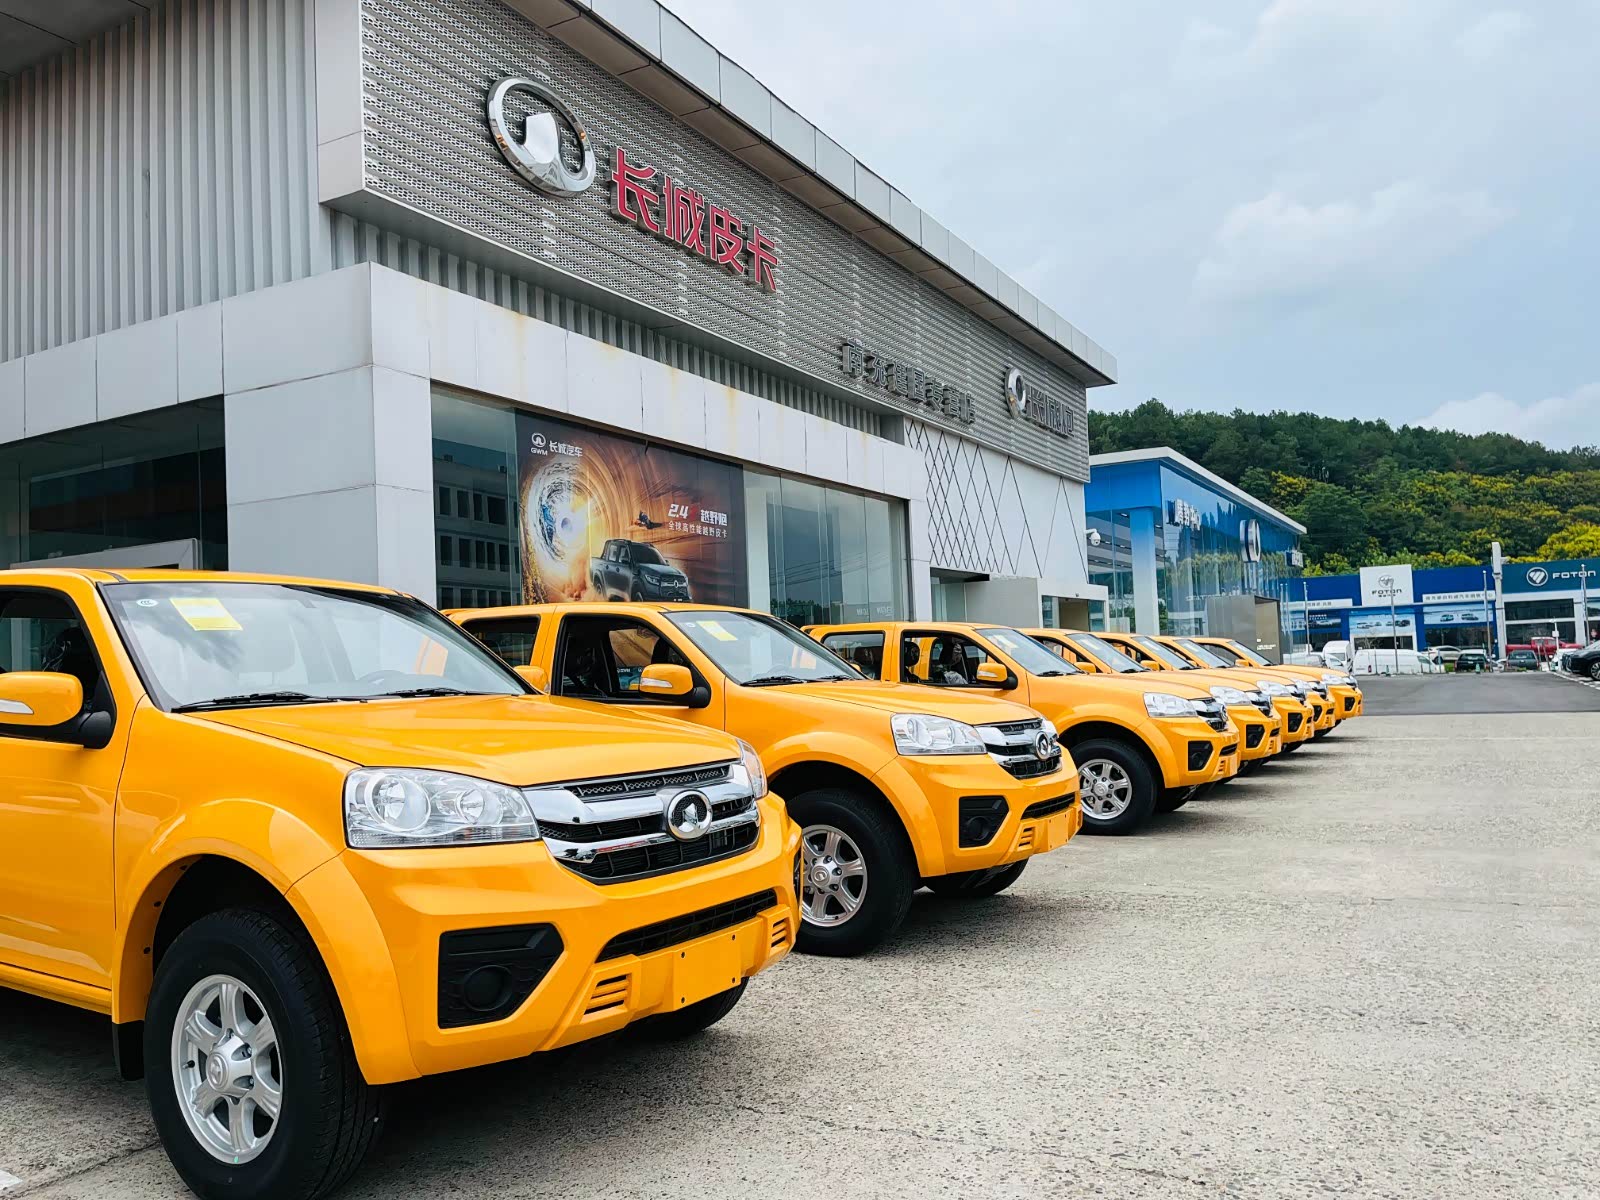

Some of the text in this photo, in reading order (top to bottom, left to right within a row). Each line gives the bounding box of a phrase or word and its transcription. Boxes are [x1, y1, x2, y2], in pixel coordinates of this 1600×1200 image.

[611, 146, 778, 291] 长城皮卡
[530, 447, 548, 456] GWM
[549, 440, 583, 458] 长城汽车
[668, 520, 728, 539] 全球高性能越野皮卡
[1552, 570, 1596, 580] FOTON
